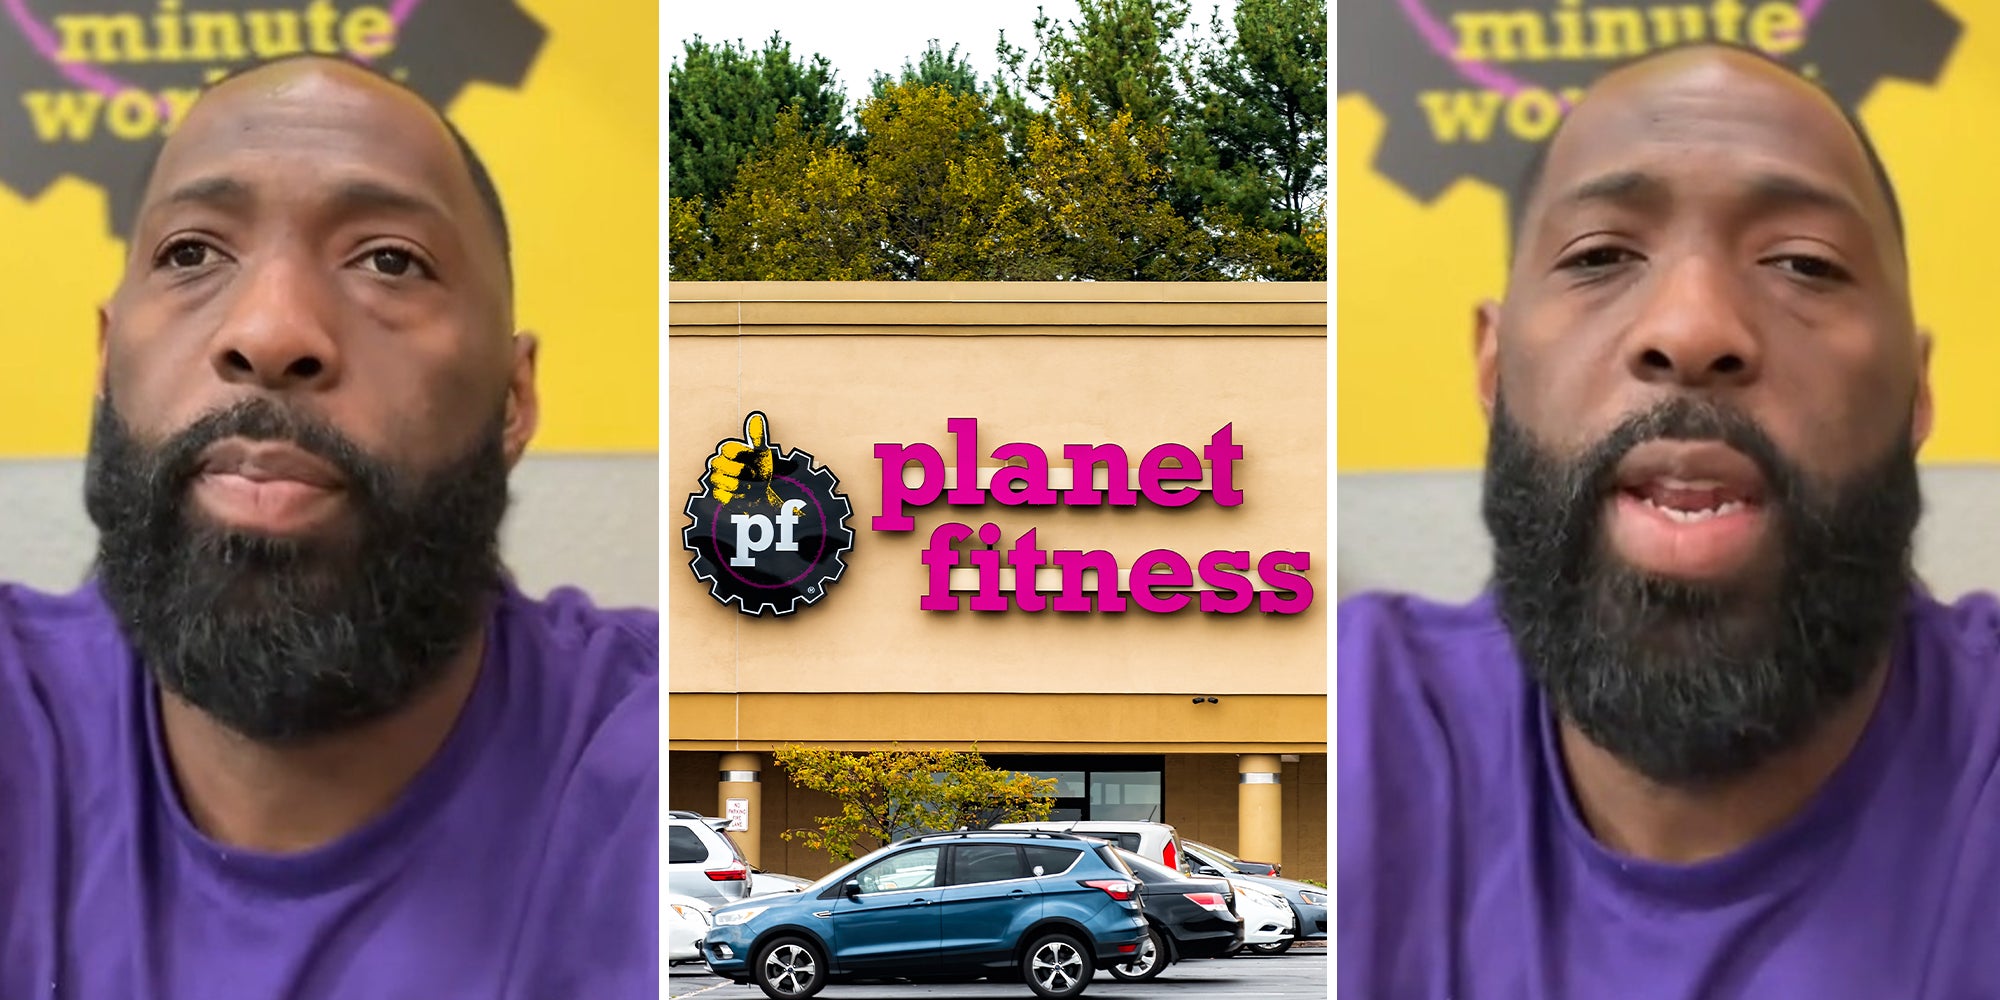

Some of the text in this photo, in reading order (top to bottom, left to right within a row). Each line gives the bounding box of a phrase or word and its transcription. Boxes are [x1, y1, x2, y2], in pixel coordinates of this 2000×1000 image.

[54, 0, 395, 62] minute
[1452, 0, 1806, 62] minute
[872, 417, 1244, 532] planet
[730, 499, 807, 567] pf
[920, 522, 1315, 615] fitness
